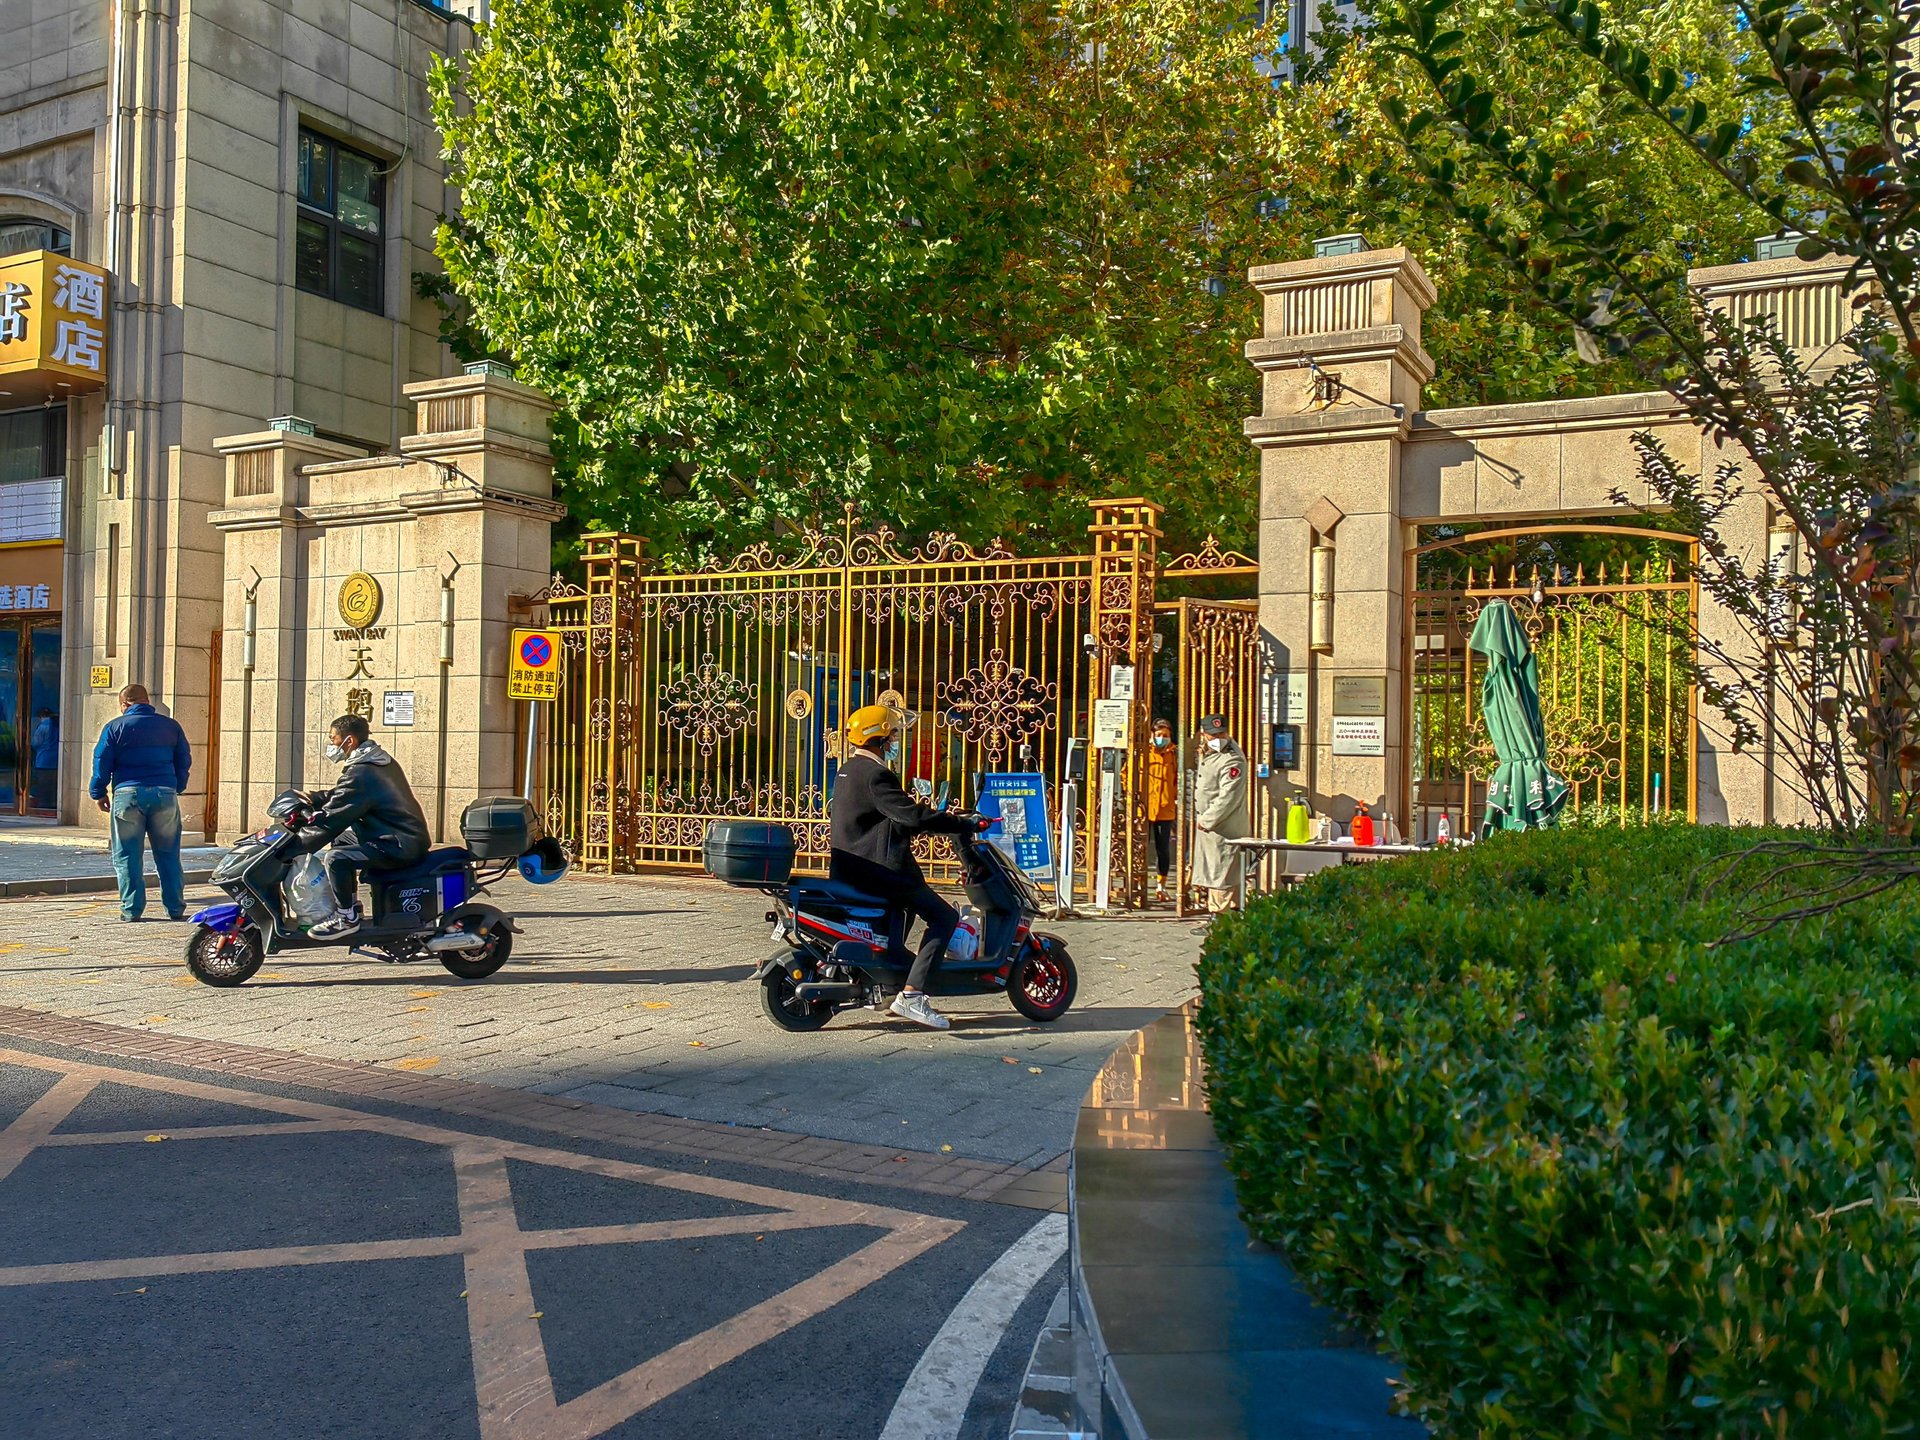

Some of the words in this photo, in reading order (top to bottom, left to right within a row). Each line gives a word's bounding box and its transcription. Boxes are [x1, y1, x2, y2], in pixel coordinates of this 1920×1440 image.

[50, 263, 104, 371] 酒店
[333, 628, 365, 641] SWAN
[366, 627, 387, 640] BAY
[513, 669, 555, 683] 消防通道
[512, 682, 554, 696] 禁止停车
